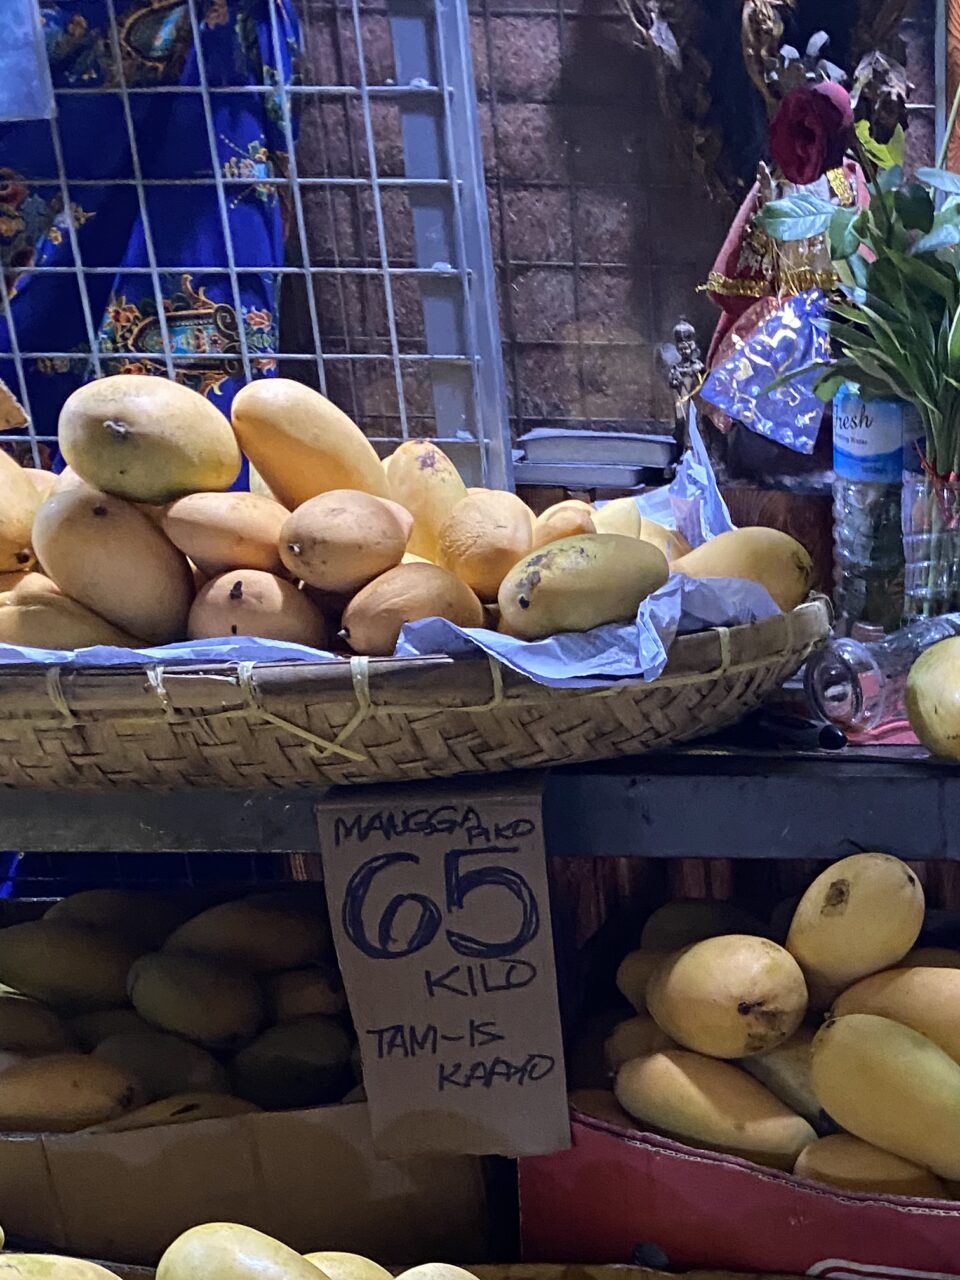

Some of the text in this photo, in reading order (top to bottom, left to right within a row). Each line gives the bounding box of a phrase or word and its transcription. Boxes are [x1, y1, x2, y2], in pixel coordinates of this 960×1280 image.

[334, 806, 481, 846] MANGGA
[342, 847, 540, 960] 65
[425, 958, 537, 997] KILO
[366, 1019, 505, 1058] TAM-IS
